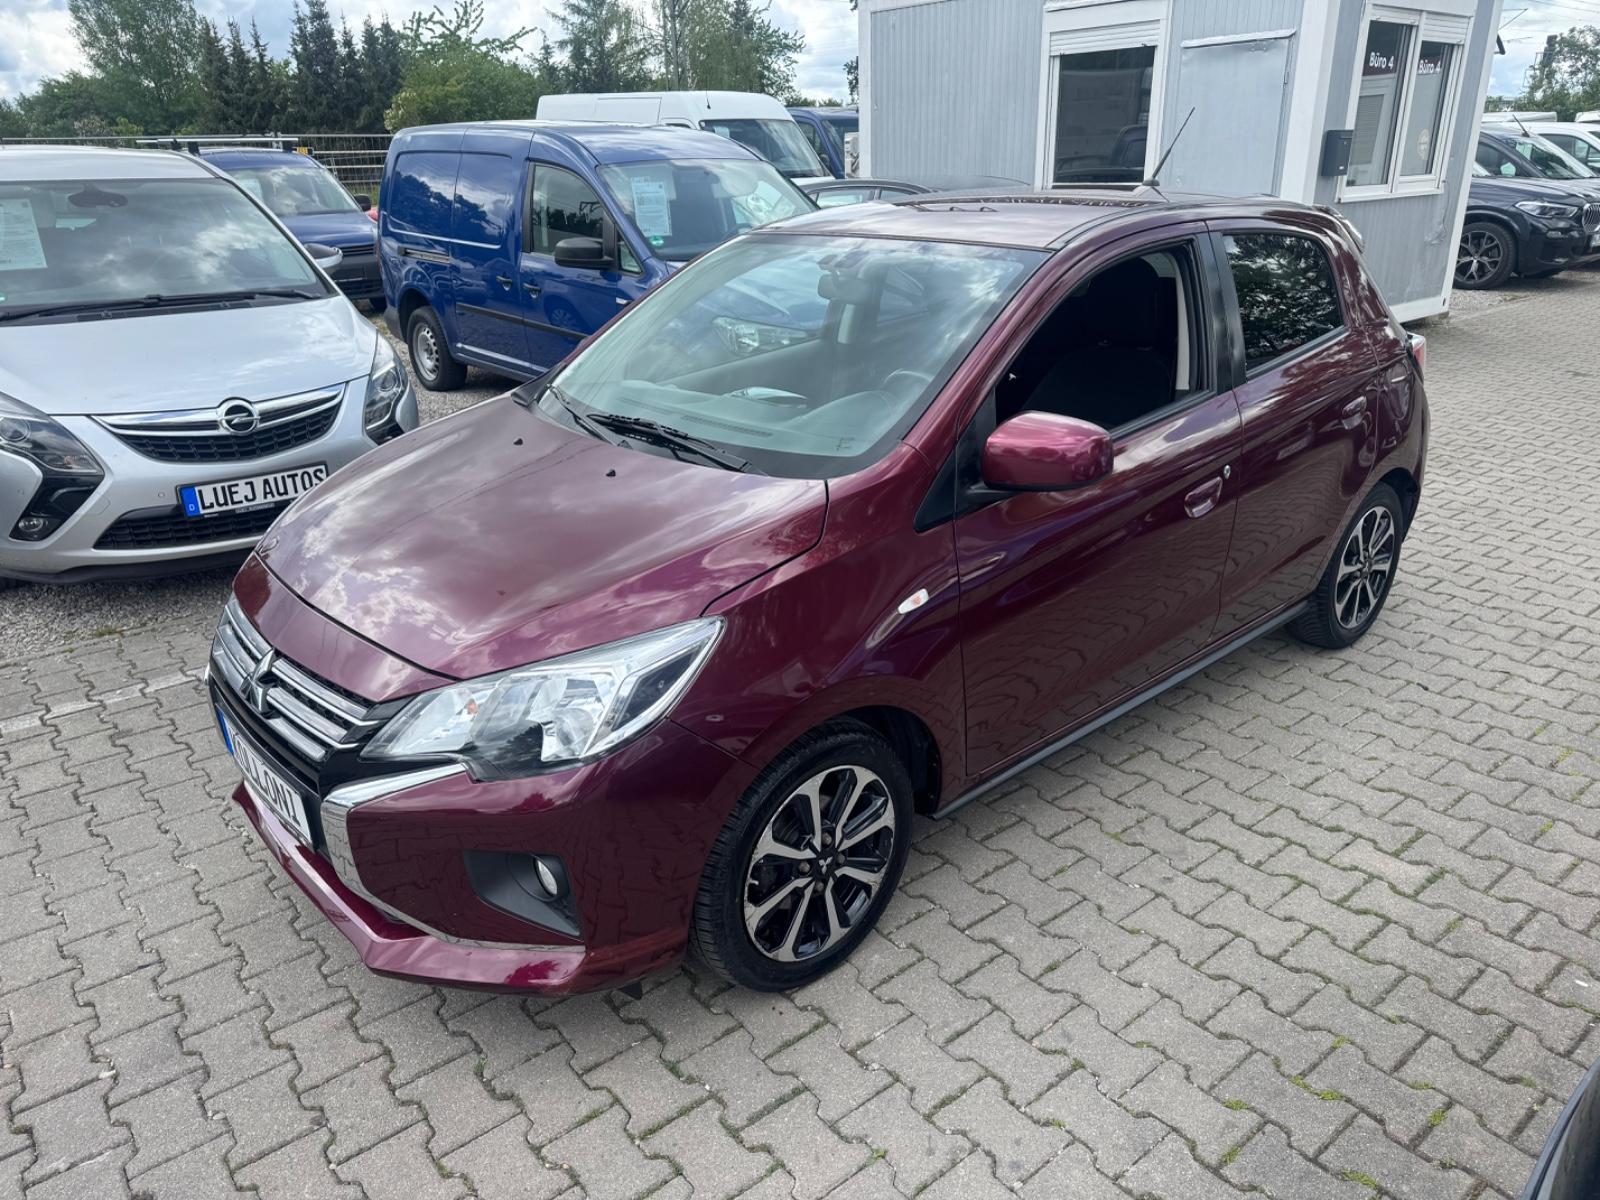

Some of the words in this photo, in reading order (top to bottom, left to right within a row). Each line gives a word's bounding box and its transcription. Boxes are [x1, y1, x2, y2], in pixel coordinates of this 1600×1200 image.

[1369, 52, 1386, 68] Büro
[1388, 55, 1394, 69] 4
[1419, 60, 1434, 73] Büro
[1435, 61, 1441, 74] 4
[198, 480, 257, 510] LUEJ
[262, 468, 325, 500] AUTOS
